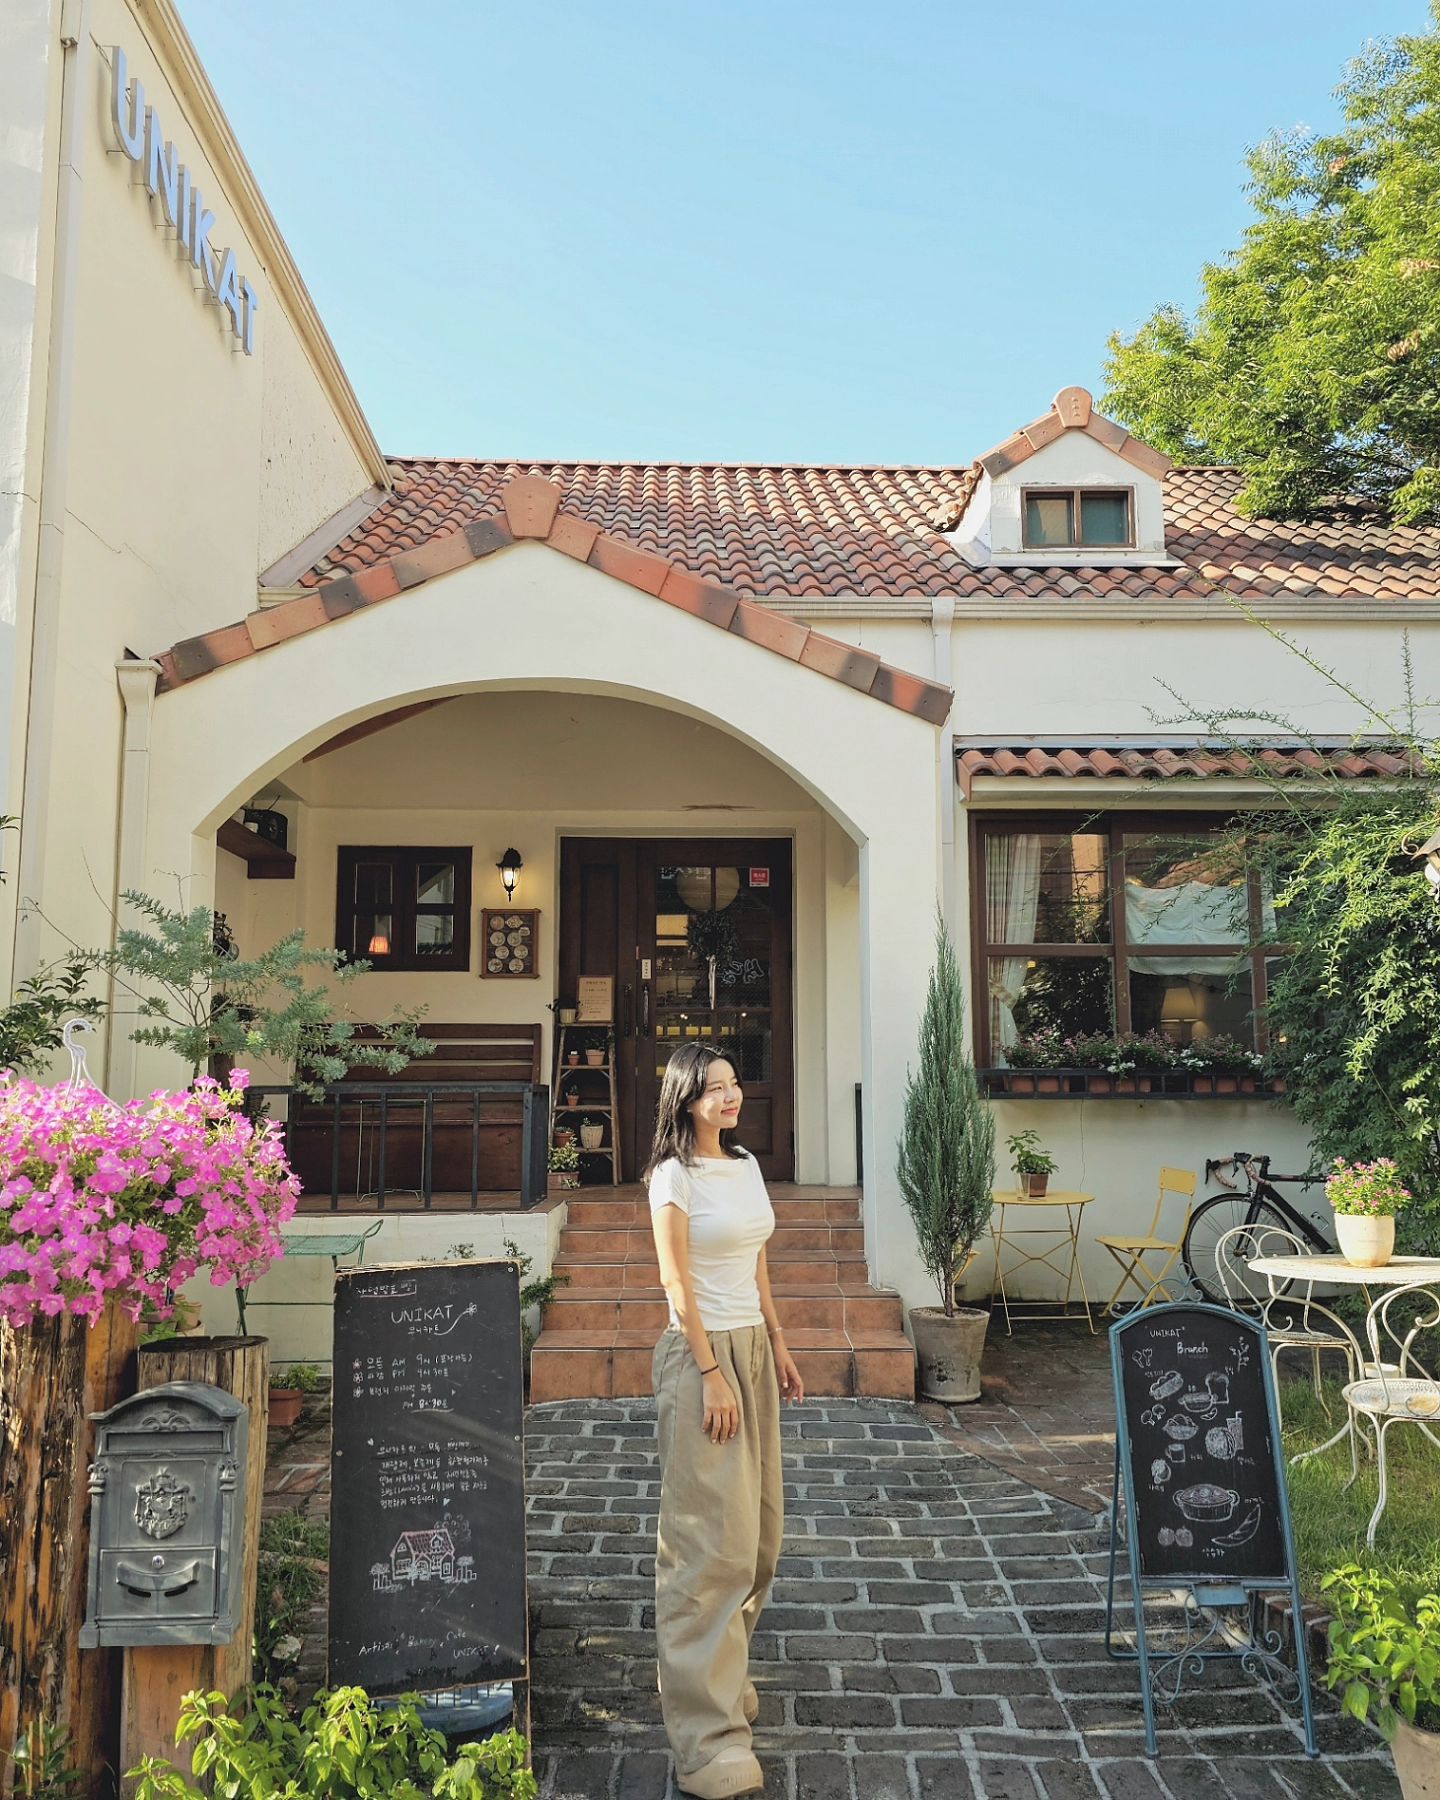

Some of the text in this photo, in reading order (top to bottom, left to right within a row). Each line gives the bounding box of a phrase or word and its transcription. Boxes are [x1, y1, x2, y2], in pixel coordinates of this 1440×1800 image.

[112, 46, 258, 356] UNIKAT
[391, 1304, 453, 1324] UNIKAT
[367, 1356, 383, 1369] 오픈
[392, 1358, 406, 1367] AM
[392, 1369, 405, 1379] PM
